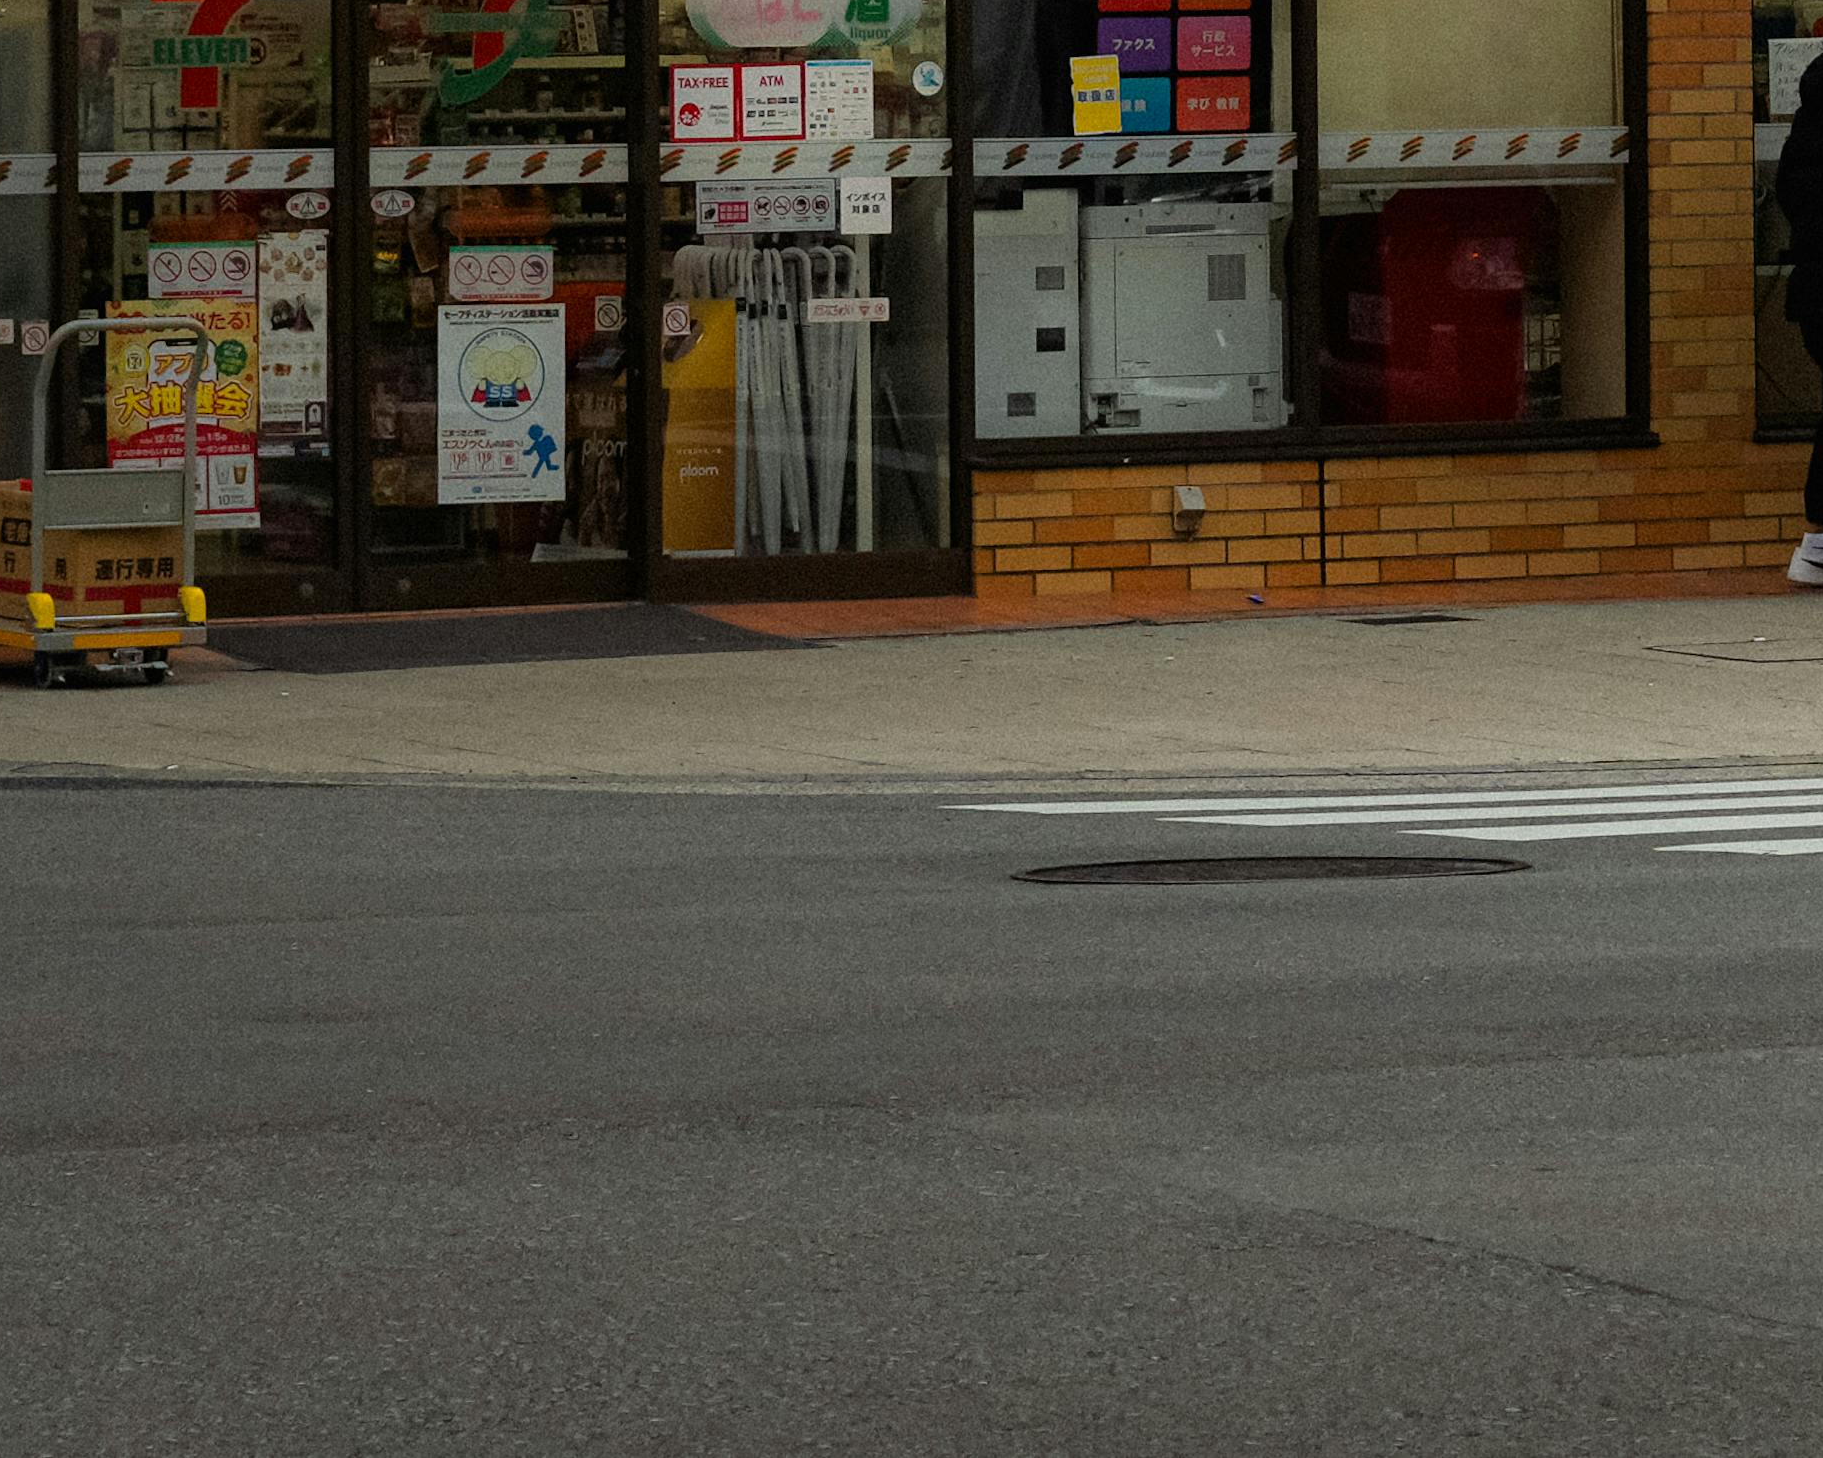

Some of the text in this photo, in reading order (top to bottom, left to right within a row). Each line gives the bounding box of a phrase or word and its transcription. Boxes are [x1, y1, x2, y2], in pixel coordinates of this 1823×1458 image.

[1112, 38, 1156, 51] ファクス
[1191, 45, 1236, 57] サービス
[759, 75, 784, 87] ATM
[846, 192, 887, 203] インボイス
[490, 387, 512, 398] SS
[679, 462, 719, 484] ploom
[95, 556, 174, 582] 運行専用
